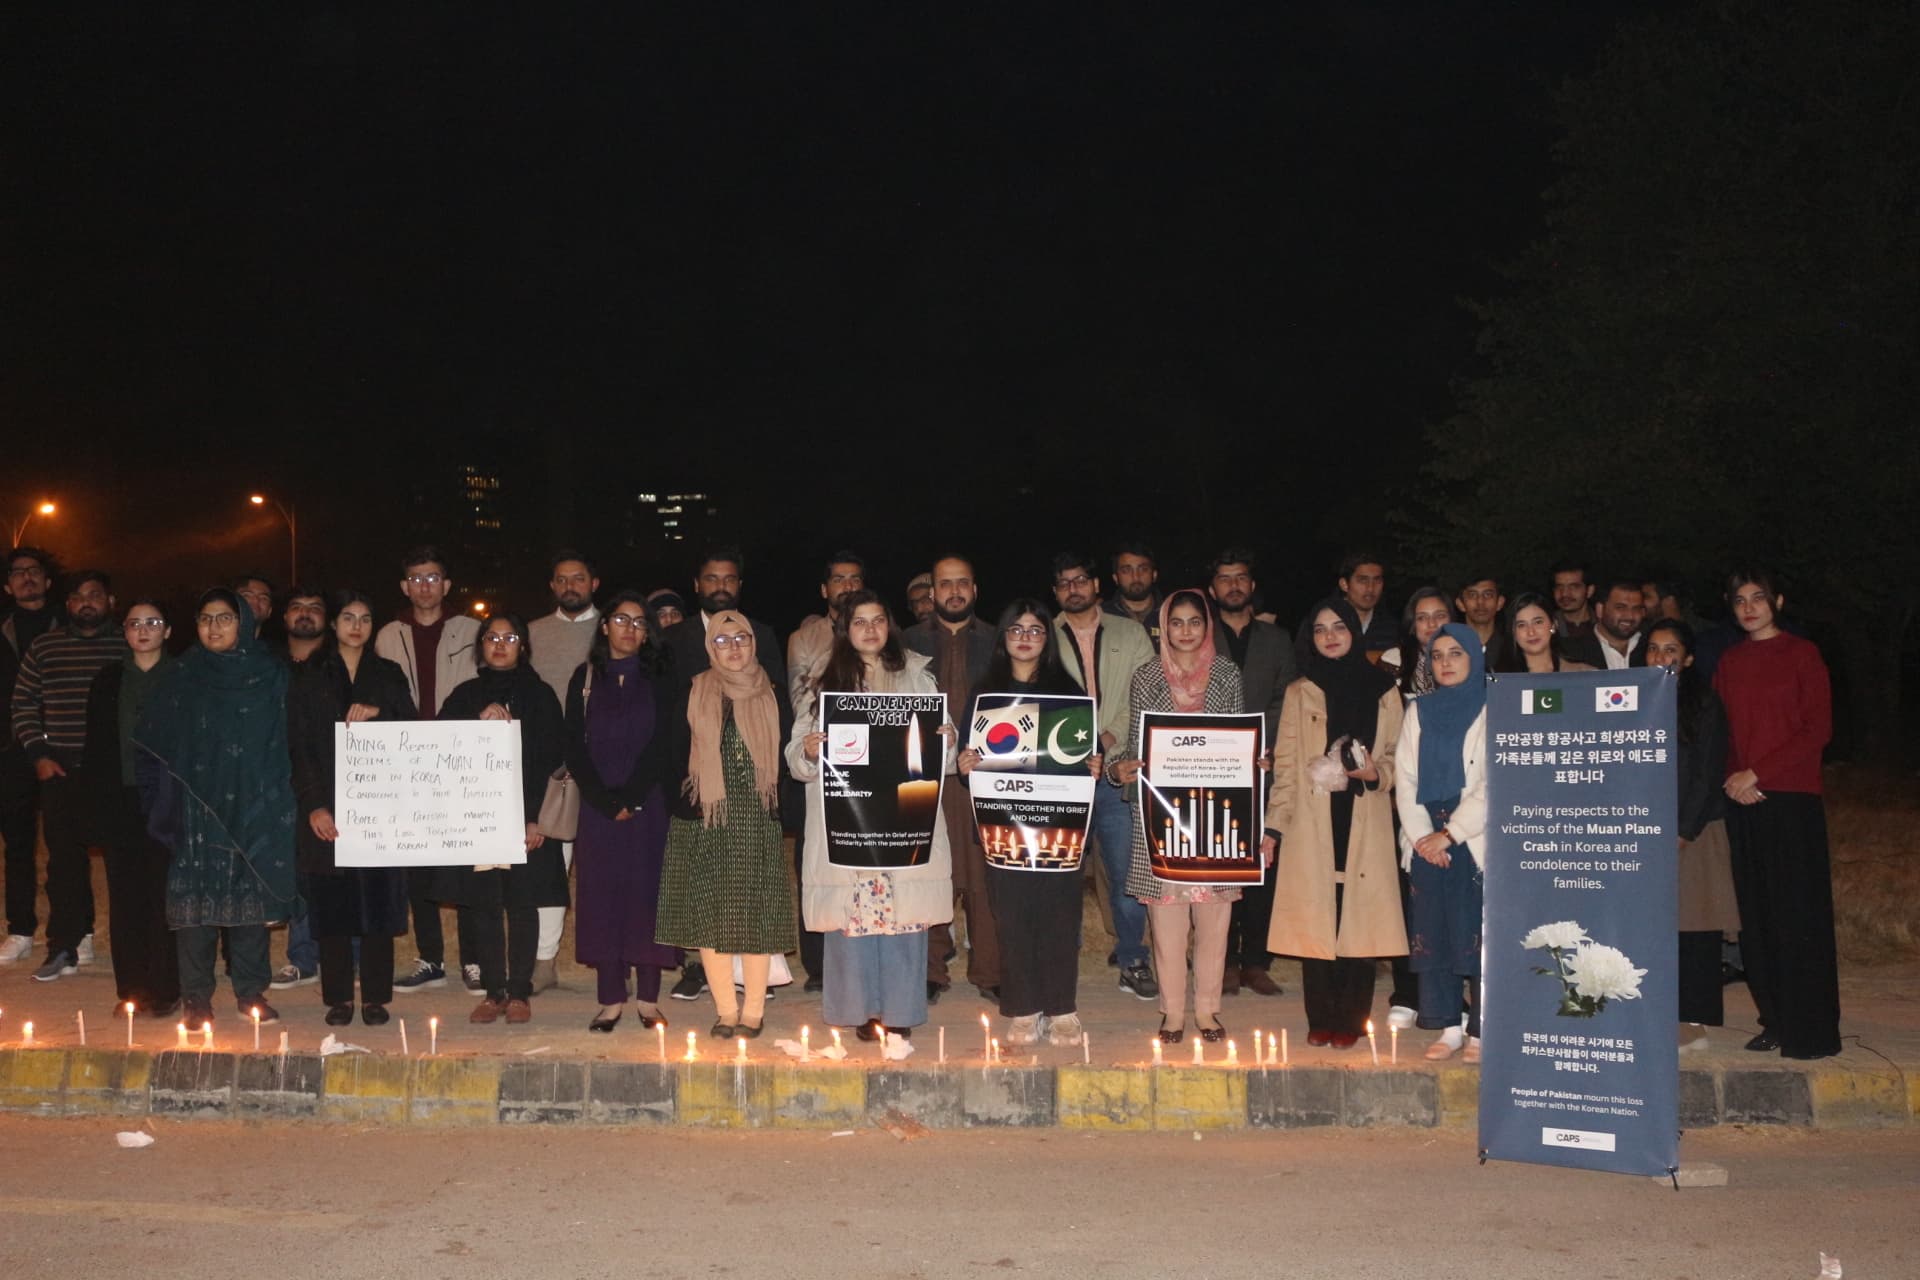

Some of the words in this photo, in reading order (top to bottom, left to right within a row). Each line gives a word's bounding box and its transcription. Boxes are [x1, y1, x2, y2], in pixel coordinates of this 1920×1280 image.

[1171, 736, 1206, 747] CAPS
[1495, 732, 1544, 747] 무안공항
[1547, 731, 1597, 746] 항공사고
[1600, 729, 1651, 744] 희생자와
[1653, 729, 1667, 743] 유
[1495, 751, 1556, 766] 가족분들께
[1560, 751, 1585, 765] 깊은
[1587, 749, 1625, 764] 위로와
[1628, 748, 1667, 763] 애도를
[1554, 770, 1605, 784] 표합니다
[994, 779, 1034, 793] CAPS
[975, 802, 1013, 811] STANDING
[1014, 804, 1055, 813] TOGETHER
[1065, 806, 1087, 814] GRIEF
[1513, 806, 1553, 819] Paying
[1555, 807, 1608, 819] respects
[1612, 806, 1623, 816] to
[1628, 806, 1649, 816] the
[1010, 814, 1027, 822] AND
[1028, 815, 1050, 823] HOPE
[1501, 824, 1545, 834] victims
[1547, 823, 1560, 834] of
[1563, 824, 1583, 834] the
[1586, 824, 1622, 834] Muan
[1625, 824, 1661, 834] Plane
[831, 831, 856, 839] Standing
[1523, 841, 1558, 852] Crash
[1561, 842, 1572, 852] in
[1575, 842, 1611, 852] Korea
[1614, 842, 1638, 852] and
[1520, 860, 1591, 870] condolence
[1594, 861, 1607, 870] to
[1611, 860, 1641, 871] their
[1553, 877, 1605, 889] families.
[1523, 1033, 1547, 1044] 한국의
[1550, 1035, 1558, 1044] 이
[1560, 1035, 1586, 1046] 어려운
[1588, 1037, 1614, 1048] 시기에
[1615, 1039, 1634, 1049] 모든
[1511, 1087, 1538, 1097] People
[1539, 1089, 1548, 1097] of
[1549, 1090, 1582, 1100] Pakistan
[1583, 1095, 1609, 1103] mourn
[1610, 1096, 1626, 1104] this
[1627, 1097, 1644, 1106] loss
[1514, 1099, 1547, 1109] together
[1548, 1101, 1566, 1110] with
[1567, 1103, 1580, 1112] the
[1581, 1105, 1609, 1114] Korean
[1610, 1107, 1640, 1117] Nation.
[1556, 1133, 1580, 1143] CAPS
